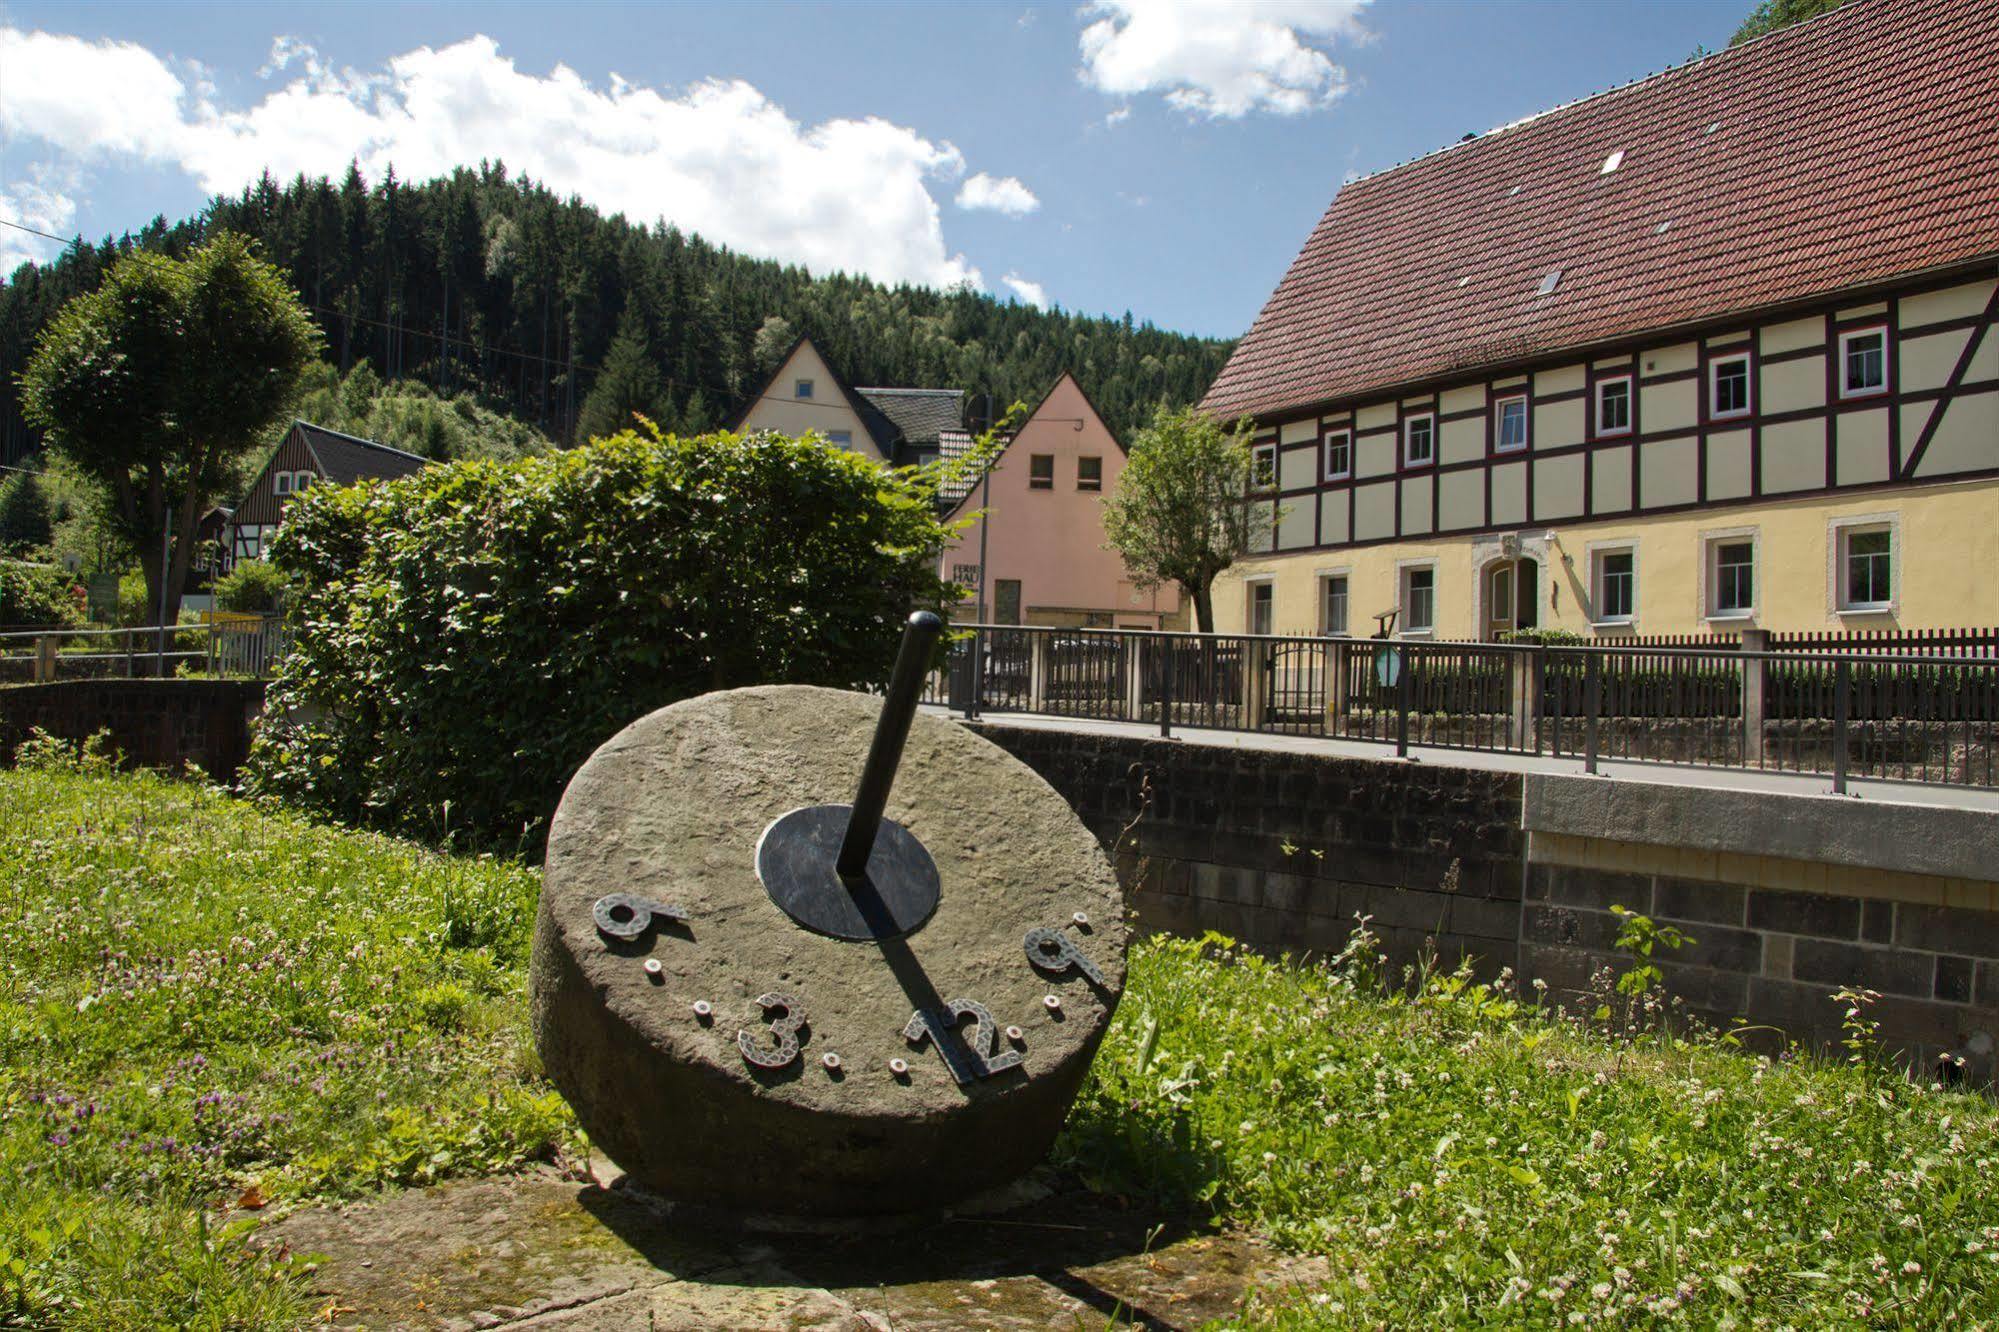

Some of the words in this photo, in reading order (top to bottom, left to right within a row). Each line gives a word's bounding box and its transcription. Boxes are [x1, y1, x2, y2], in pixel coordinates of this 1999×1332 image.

[1022, 927, 1104, 984] 9
[738, 991, 807, 1070] 3
[902, 998, 1023, 1083] 12
